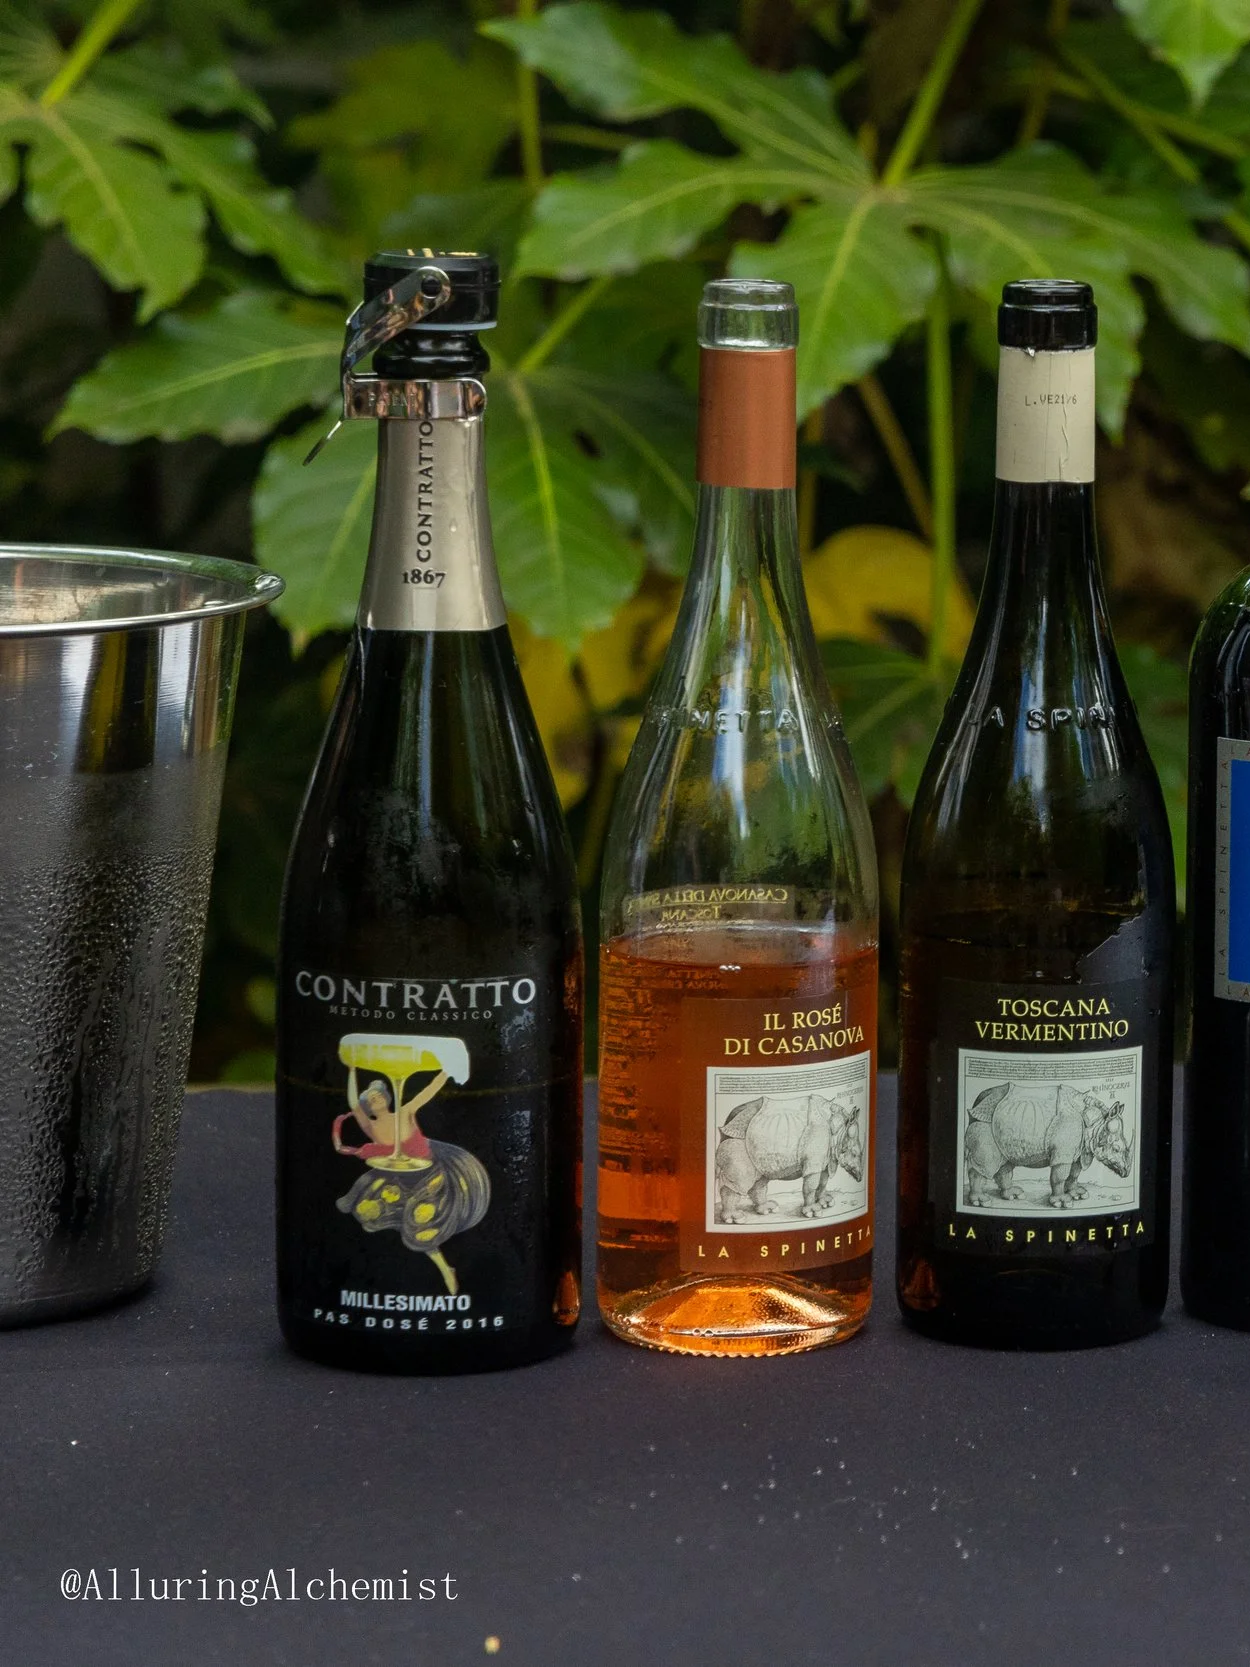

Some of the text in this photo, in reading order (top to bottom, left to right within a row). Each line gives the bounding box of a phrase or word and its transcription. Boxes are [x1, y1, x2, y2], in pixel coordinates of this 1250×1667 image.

[416, 420, 434, 563] CONTRATTO
[402, 569, 446, 588] 1867
[296, 970, 536, 1009] CONTRATTO
[329, 1004, 493, 1021] METODO CLASSICO
[763, 1002, 843, 1031] IL ROSÉ
[997, 998, 1111, 1017] TOSCANA
[724, 1025, 865, 1056] DI CASANOVA
[975, 1019, 1129, 1041] VERMENTINO
[698, 1225, 871, 1258] LA SPINETTA
[949, 1221, 1144, 1243] LA SPINETTA
[340, 1290, 471, 1312] MILLESIMATO
[313, 1308, 504, 1331] PAS DOSÉ 2016
